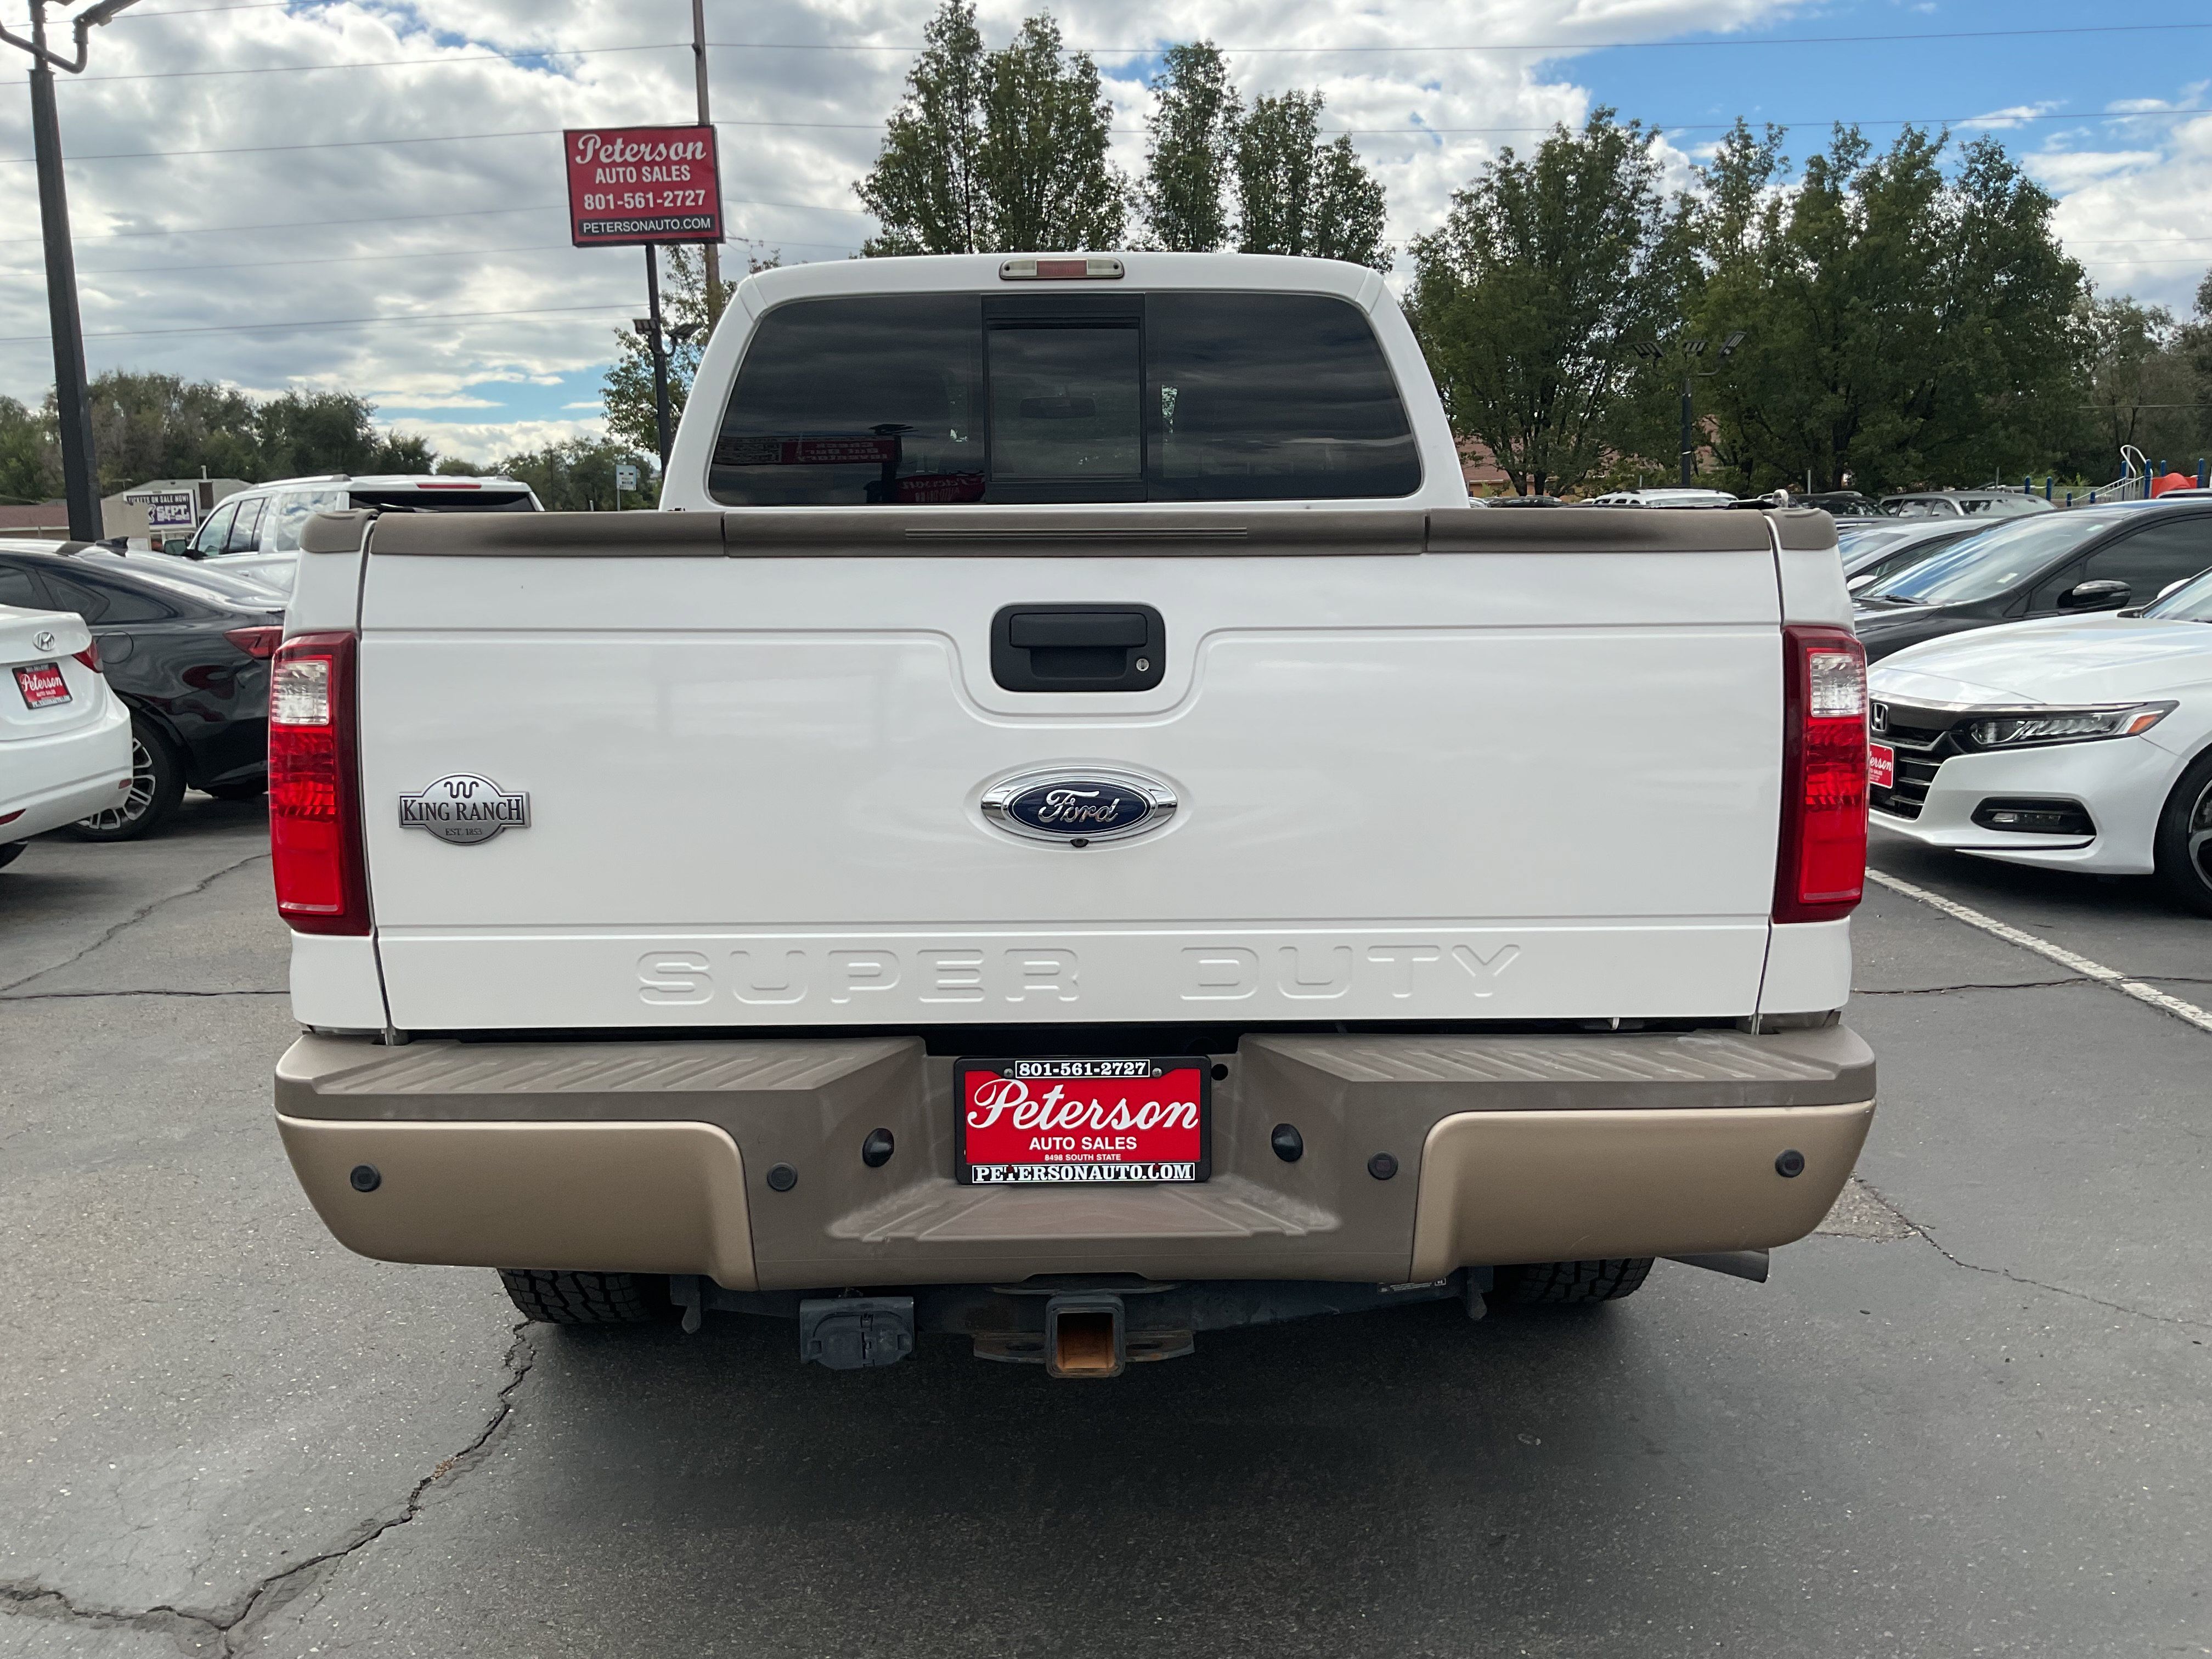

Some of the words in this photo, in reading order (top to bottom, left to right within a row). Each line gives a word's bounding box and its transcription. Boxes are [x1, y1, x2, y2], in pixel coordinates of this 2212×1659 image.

[575, 133, 706, 164] Peterson
[596, 167, 636, 184] AUTO
[641, 165, 691, 182] SALES
[584, 190, 706, 210] 801-561-2727
[583, 218, 710, 233] PETERSONAUTO.COM
[160, 495, 173, 503] SALE
[20, 674, 63, 692] Peterson
[1870, 751, 1892, 772] erson
[403, 799, 449, 821] KING
[455, 799, 521, 821] RANCH
[1038, 789, 1120, 823] Ford
[637, 948, 1079, 1005] SUPER
[1180, 944, 1521, 1000] DUTY
[1019, 1062, 1146, 1076] 801-561-2727
[967, 1078, 1199, 1130] Peterson
[1029, 1137, 1075, 1150] AUTO
[1081, 1136, 1137, 1150] SALES
